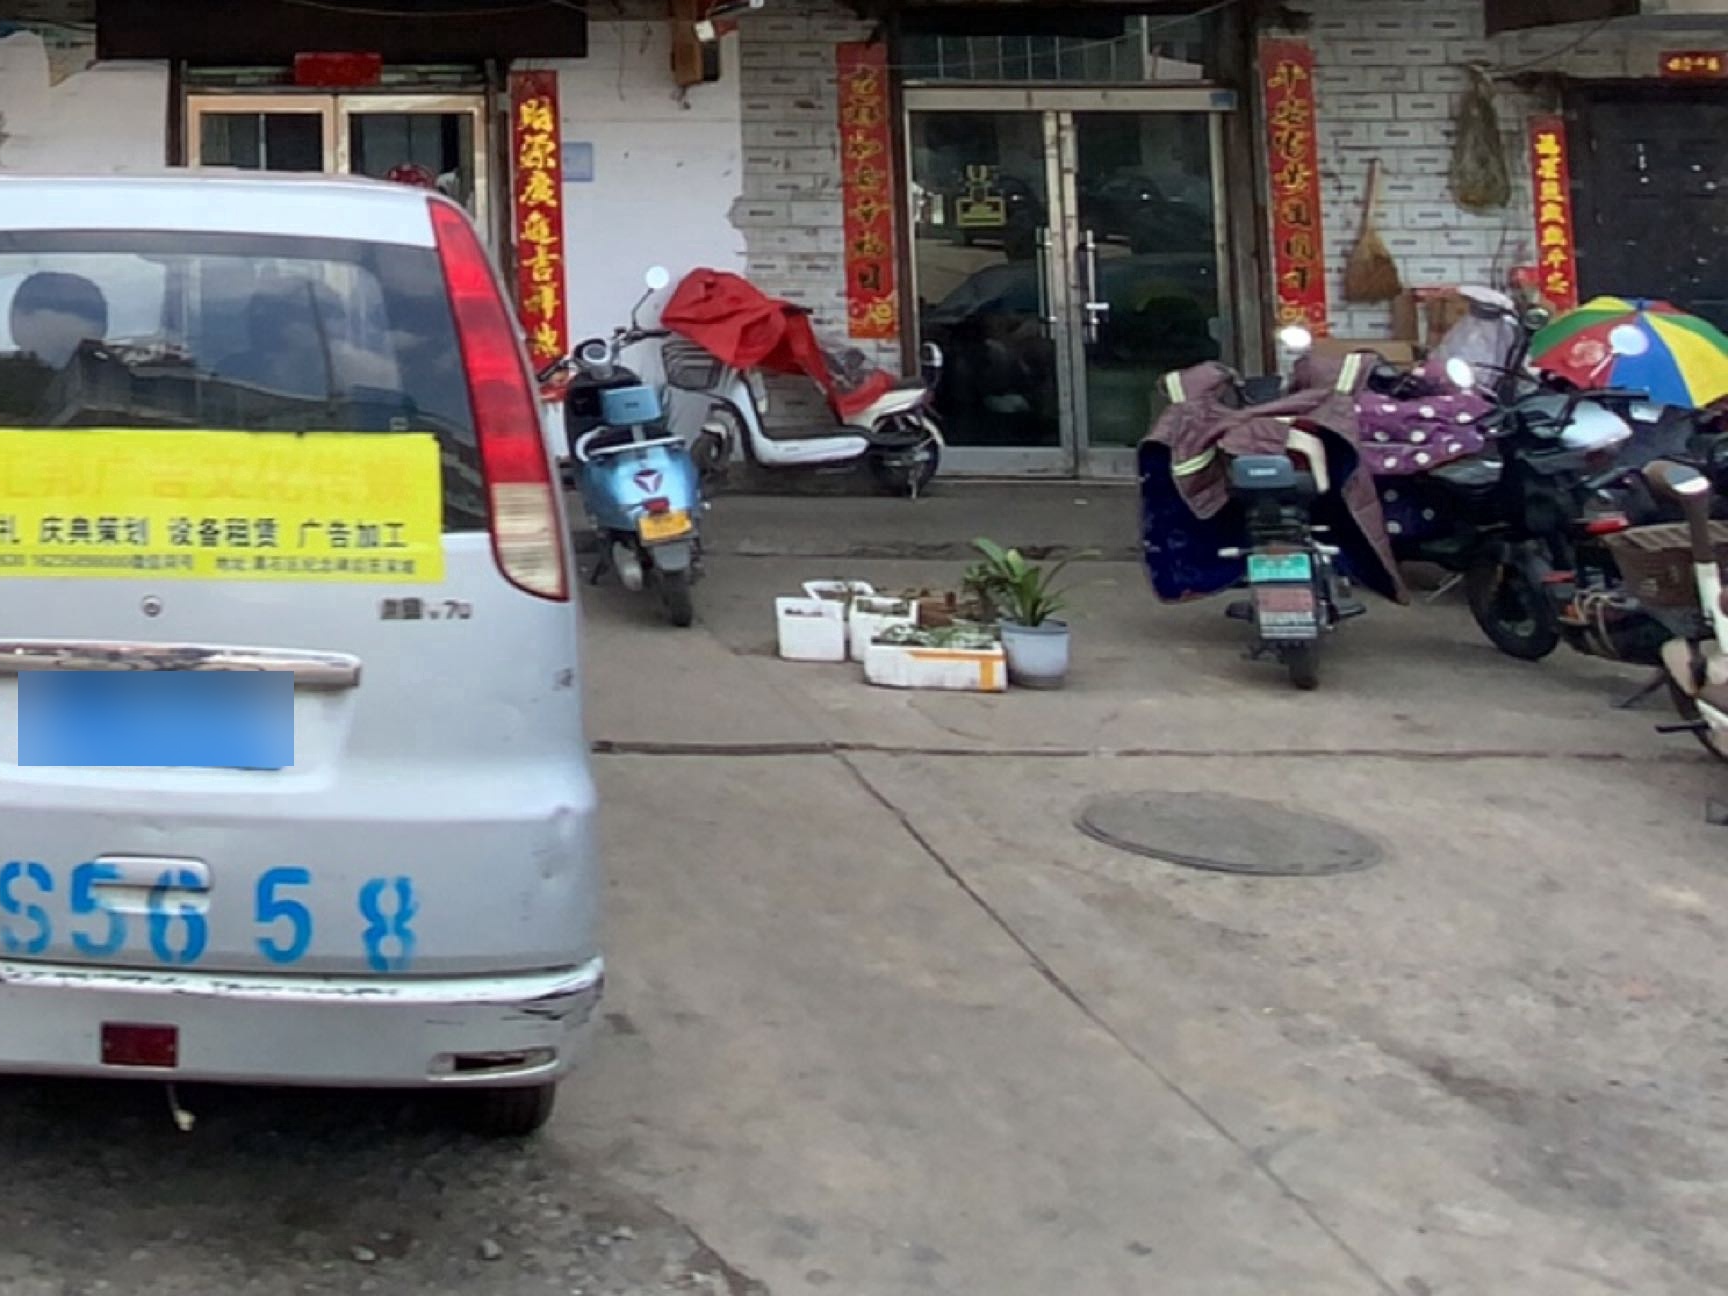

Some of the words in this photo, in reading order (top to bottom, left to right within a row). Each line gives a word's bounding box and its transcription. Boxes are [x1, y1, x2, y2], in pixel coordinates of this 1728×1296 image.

[39, 516, 150, 547] 庆典策划
[168, 517, 280, 549] 设备租赁
[297, 520, 409, 551] 广告加工
